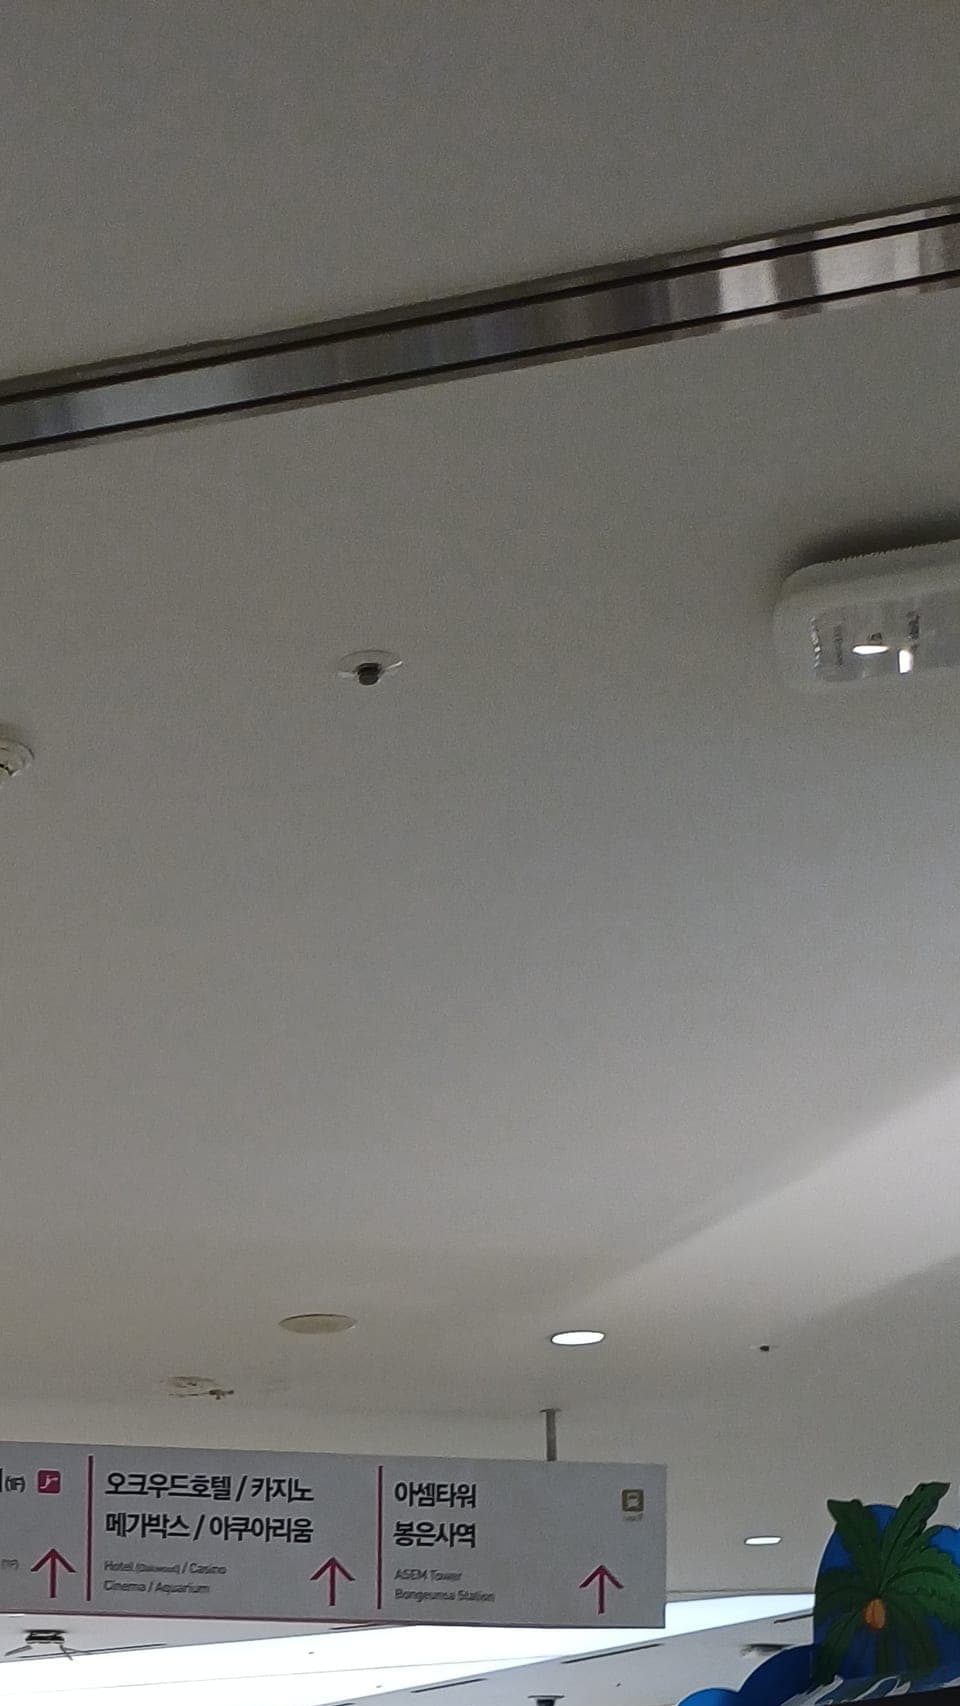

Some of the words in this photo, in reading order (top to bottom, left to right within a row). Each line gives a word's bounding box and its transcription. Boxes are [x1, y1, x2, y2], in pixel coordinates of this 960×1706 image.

[105, 1472, 231, 1501] 오크우드호텔
[251, 1477, 315, 1503] 카지노
[394, 1481, 477, 1509] 아셈타워
[105, 1512, 190, 1539] 메가박스
[209, 1515, 314, 1543] 아쿠아리움
[392, 1520, 476, 1549] 봉은사역
[103, 1560, 134, 1572] Hotel
[103, 1580, 146, 1592] Cinema
